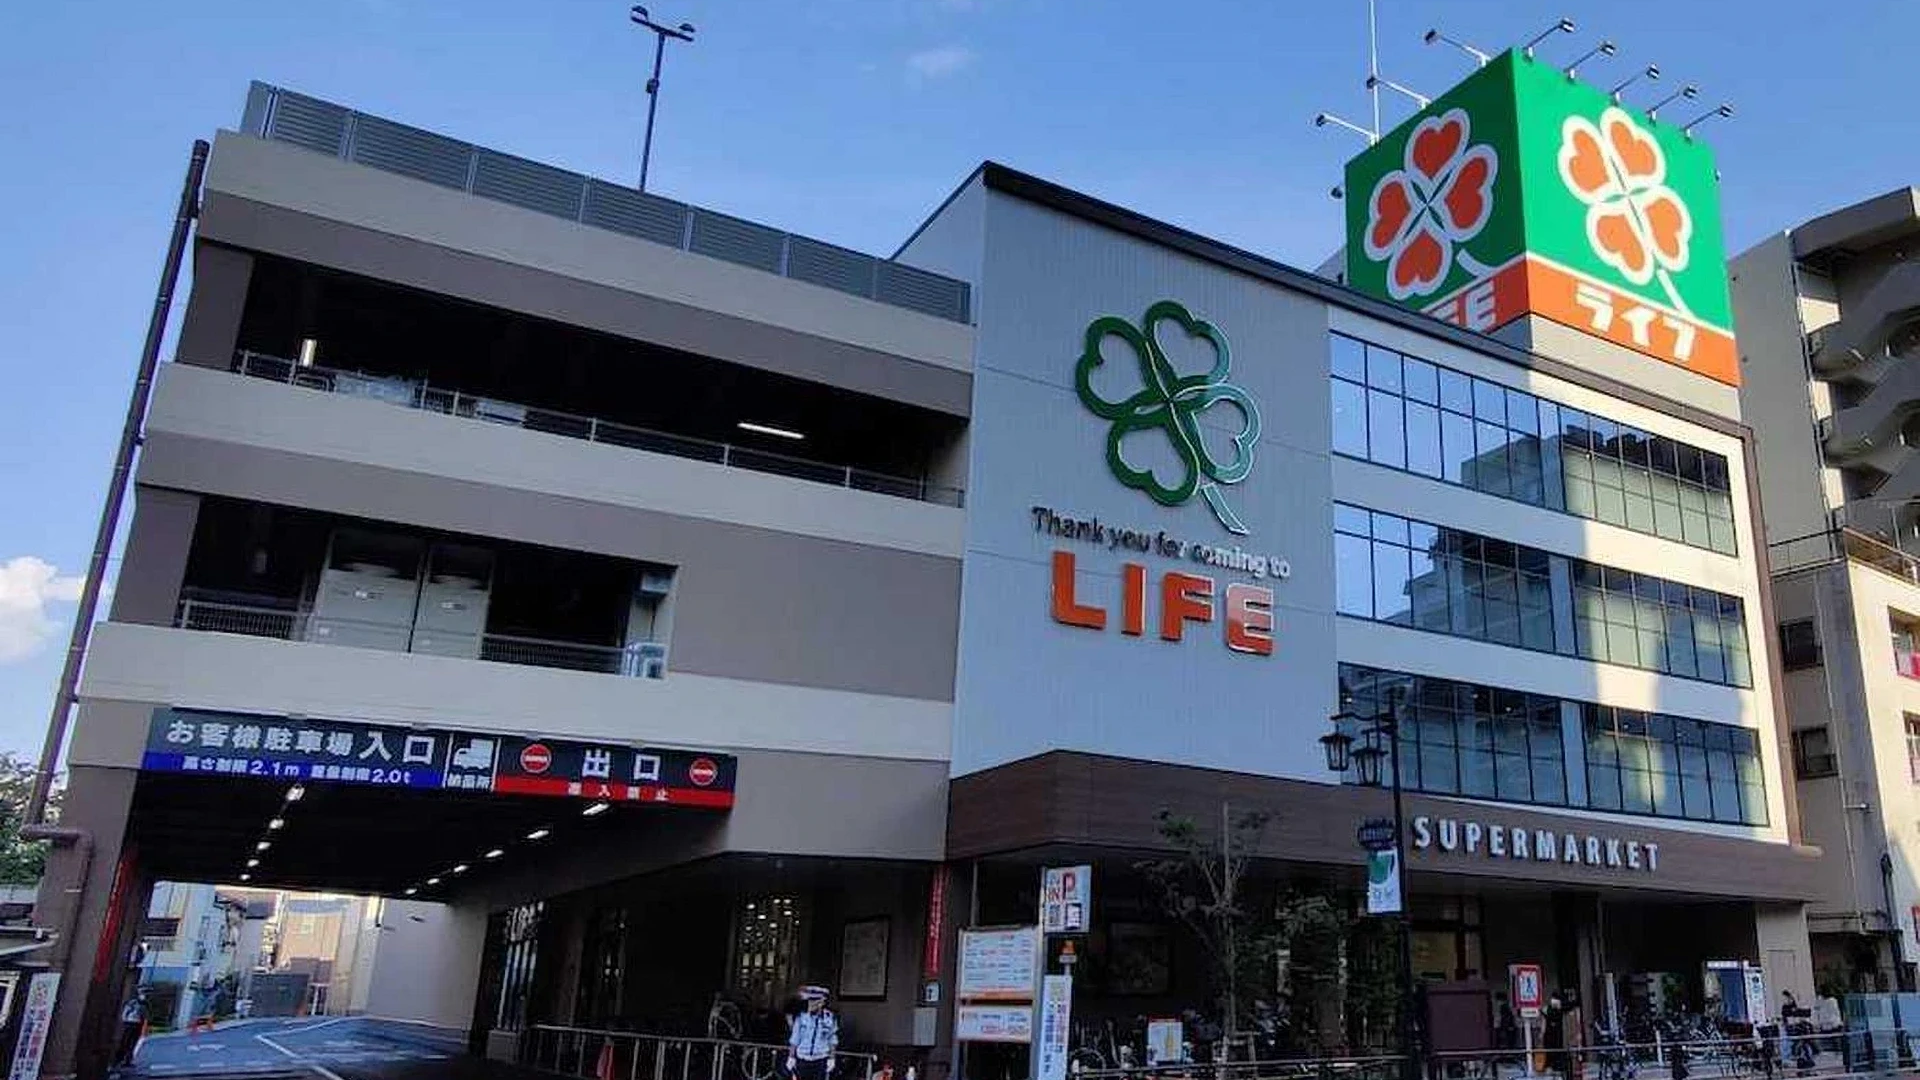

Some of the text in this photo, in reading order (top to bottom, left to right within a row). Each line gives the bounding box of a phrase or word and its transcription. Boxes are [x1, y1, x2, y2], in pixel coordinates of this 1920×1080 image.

[1576, 282, 1696, 362] ライフ
[1031, 506, 1290, 578] Thank you for coming to
[1053, 550, 1275, 655] LIFE
[166, 719, 435, 765] お客様駐車場入口
[581, 750, 661, 781] 出口
[1413, 816, 1660, 872] SUPERMARKET
[1061, 871, 1076, 900] P
